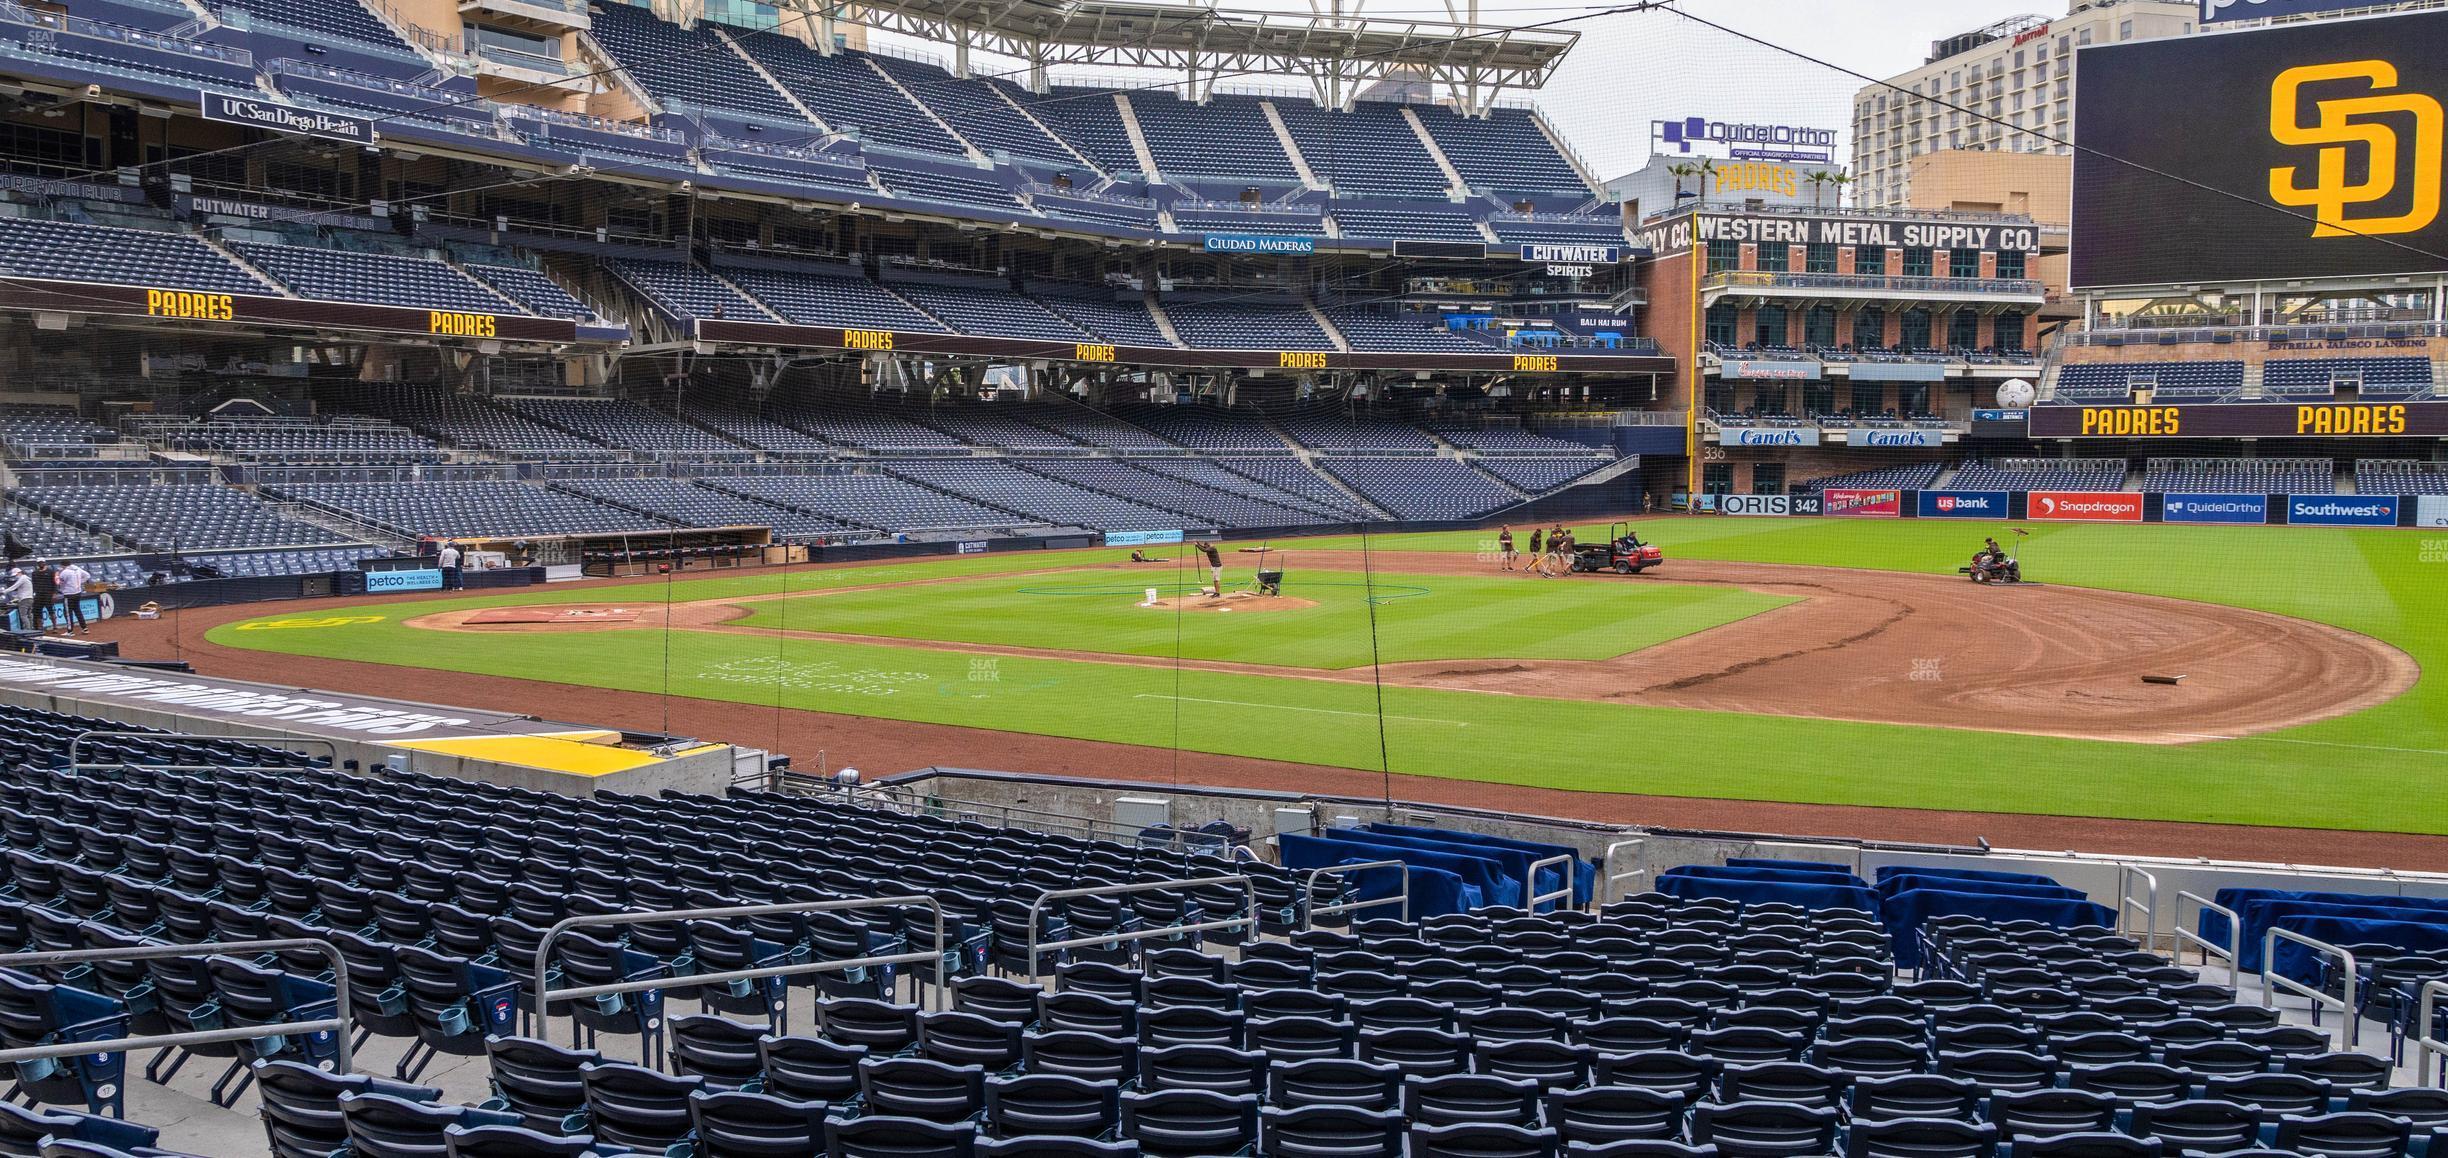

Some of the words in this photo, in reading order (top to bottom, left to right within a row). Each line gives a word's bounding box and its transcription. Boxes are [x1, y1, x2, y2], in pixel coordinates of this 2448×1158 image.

[223, 99, 248, 117] UC
[248, 104, 275, 120] San
[276, 107, 315, 131] Diego
[315, 114, 359, 136] Health
[1710, 122, 1830, 145] QuidelOrtho
[1761, 151, 1800, 159] DIAGNOSTICS
[0, 173, 79, 196] ORONADO
[1716, 161, 1797, 198] PADRES
[193, 198, 268, 219] CUTWATER
[1697, 216, 1809, 243] WESTERN
[1821, 221, 1897, 246] METAL
[1903, 224, 1991, 249] SUPPLY
[2000, 228, 2037, 251] CO.
[1208, 238, 1256, 250] CIUDAD
[1259, 239, 1312, 251] MADERAS
[1532, 246, 1608, 262] CUTWATER
[1547, 264, 1593, 277] SPIRITS
[147, 289, 233, 320] PADRES
[430, 312, 496, 337] PADRES
[1580, 319, 1597, 327] BALI
[1598, 319, 1610, 327] HAI
[844, 330, 893, 350] PADRES
[2268, 342, 2324, 351] ESTRELLA
[2326, 341, 2372, 350] JALISCO
[2375, 340, 2427, 348] LANDING
[1076, 343, 1115, 361] PADRES
[1280, 352, 1327, 368] PADRES
[1514, 355, 1557, 371] PADRES
[2081, 407, 2179, 435] PADRES
[2296, 405, 2406, 434] PADRES
[1739, 429, 1801, 446] Canel's
[1866, 430, 1925, 446] Canel's
[1703, 446, 1726, 460] 336
[1725, 495, 1787, 514] ORIS
[1795, 498, 1819, 512] 342
[1938, 499, 1954, 508] us
[2060, 500, 2135, 515] Snapdragon
[2187, 501, 2262, 514] QuidelOrtho
[2295, 503, 2379, 517] Southwest
[369, 575, 405, 590] petco
